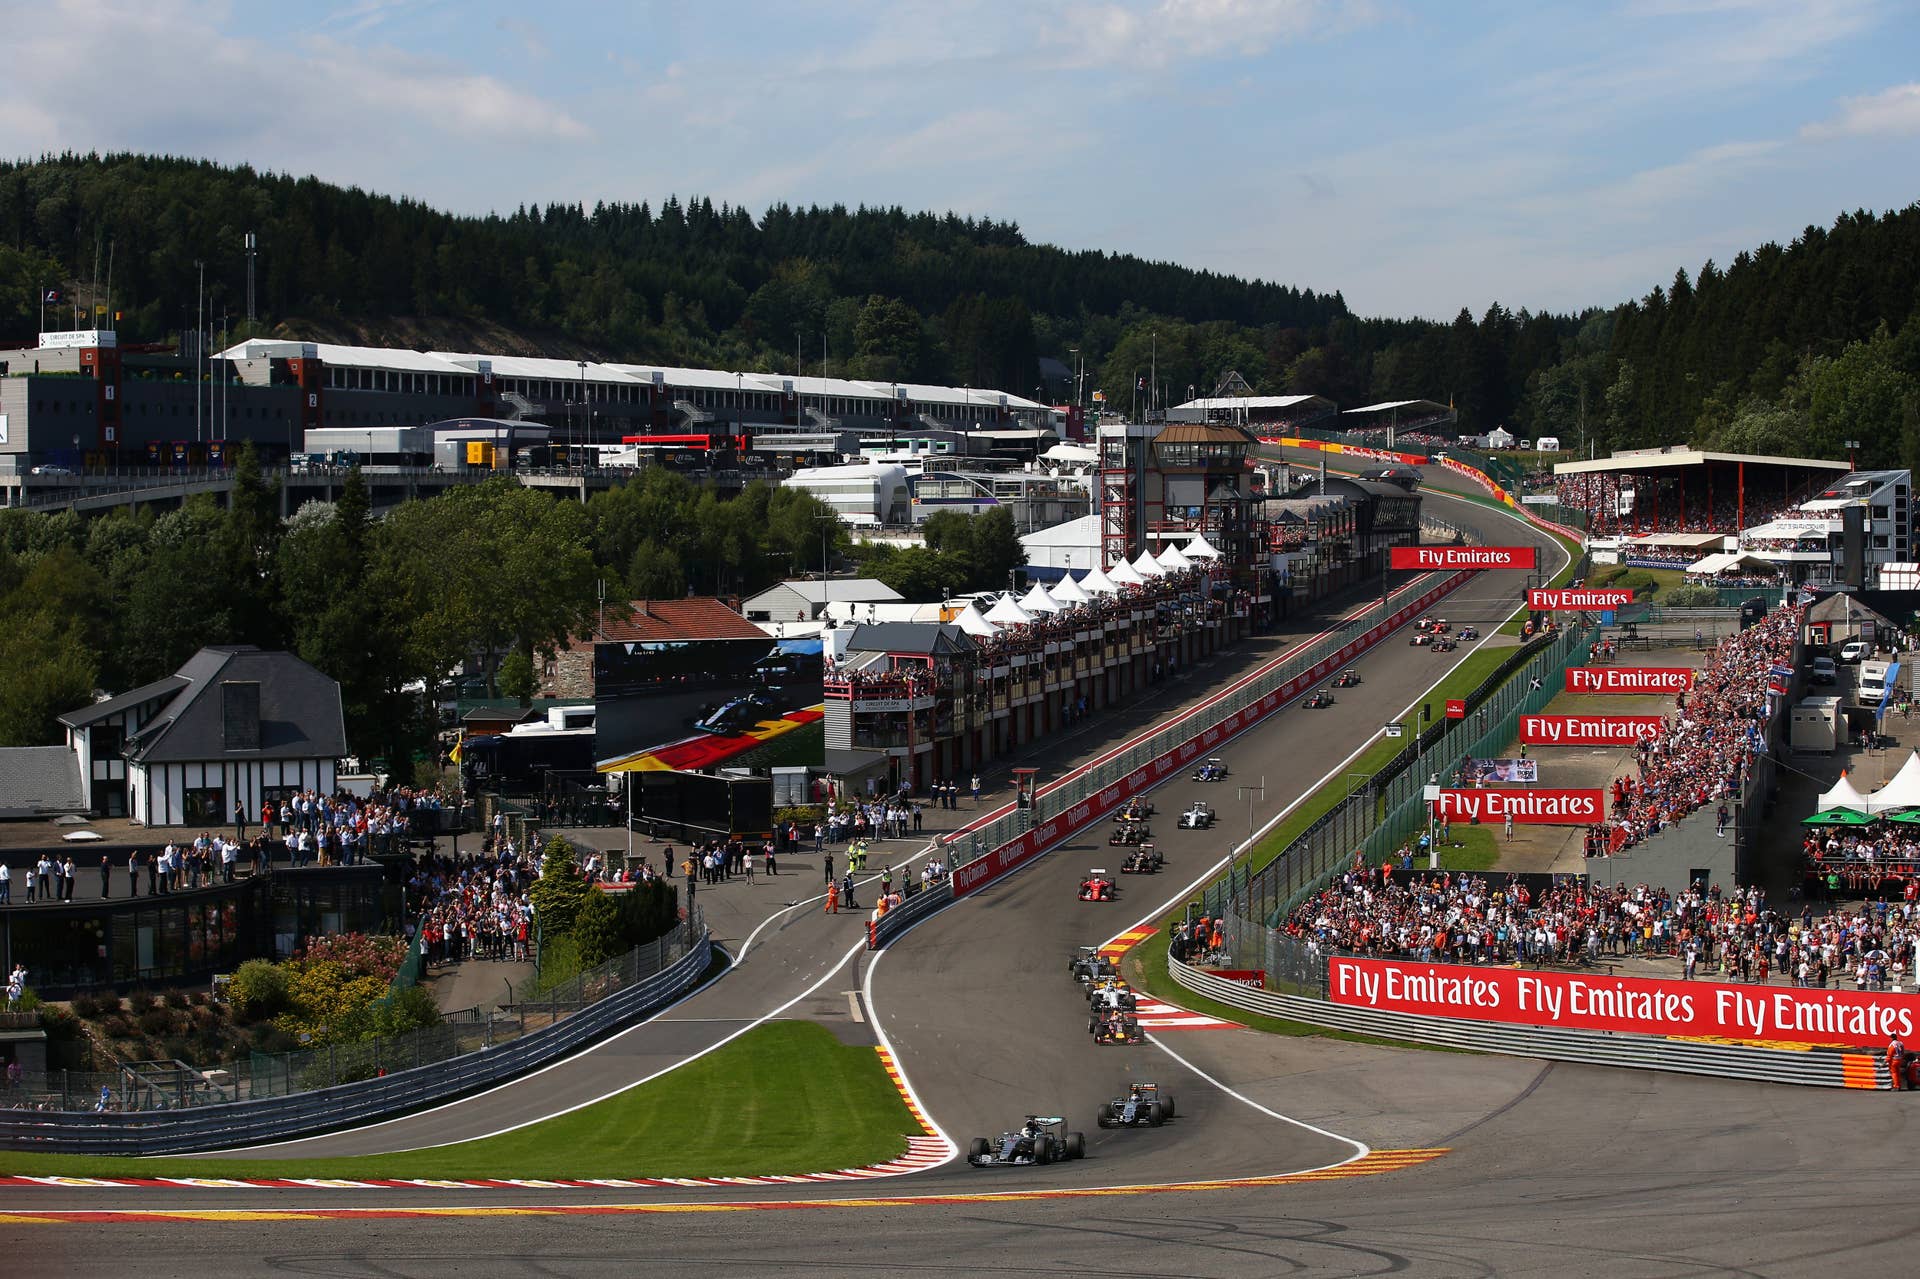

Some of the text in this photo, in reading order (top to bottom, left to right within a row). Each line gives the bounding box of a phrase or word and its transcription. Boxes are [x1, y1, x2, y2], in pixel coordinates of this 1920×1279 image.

[1419, 549, 1511, 566] Fly Emirates
[1533, 592, 1628, 608] Fly Emirates
[1573, 670, 1687, 690] Fly Emirates
[1526, 718, 1657, 741] Fly Emirates
[1439, 792, 1595, 817] Fly Emirates
[1006, 841, 1025, 862] Emirates
[968, 862, 989, 883] Emirates
[1338, 964, 1913, 1037] Fly Emirates Fly Emirates Fly Emirates
